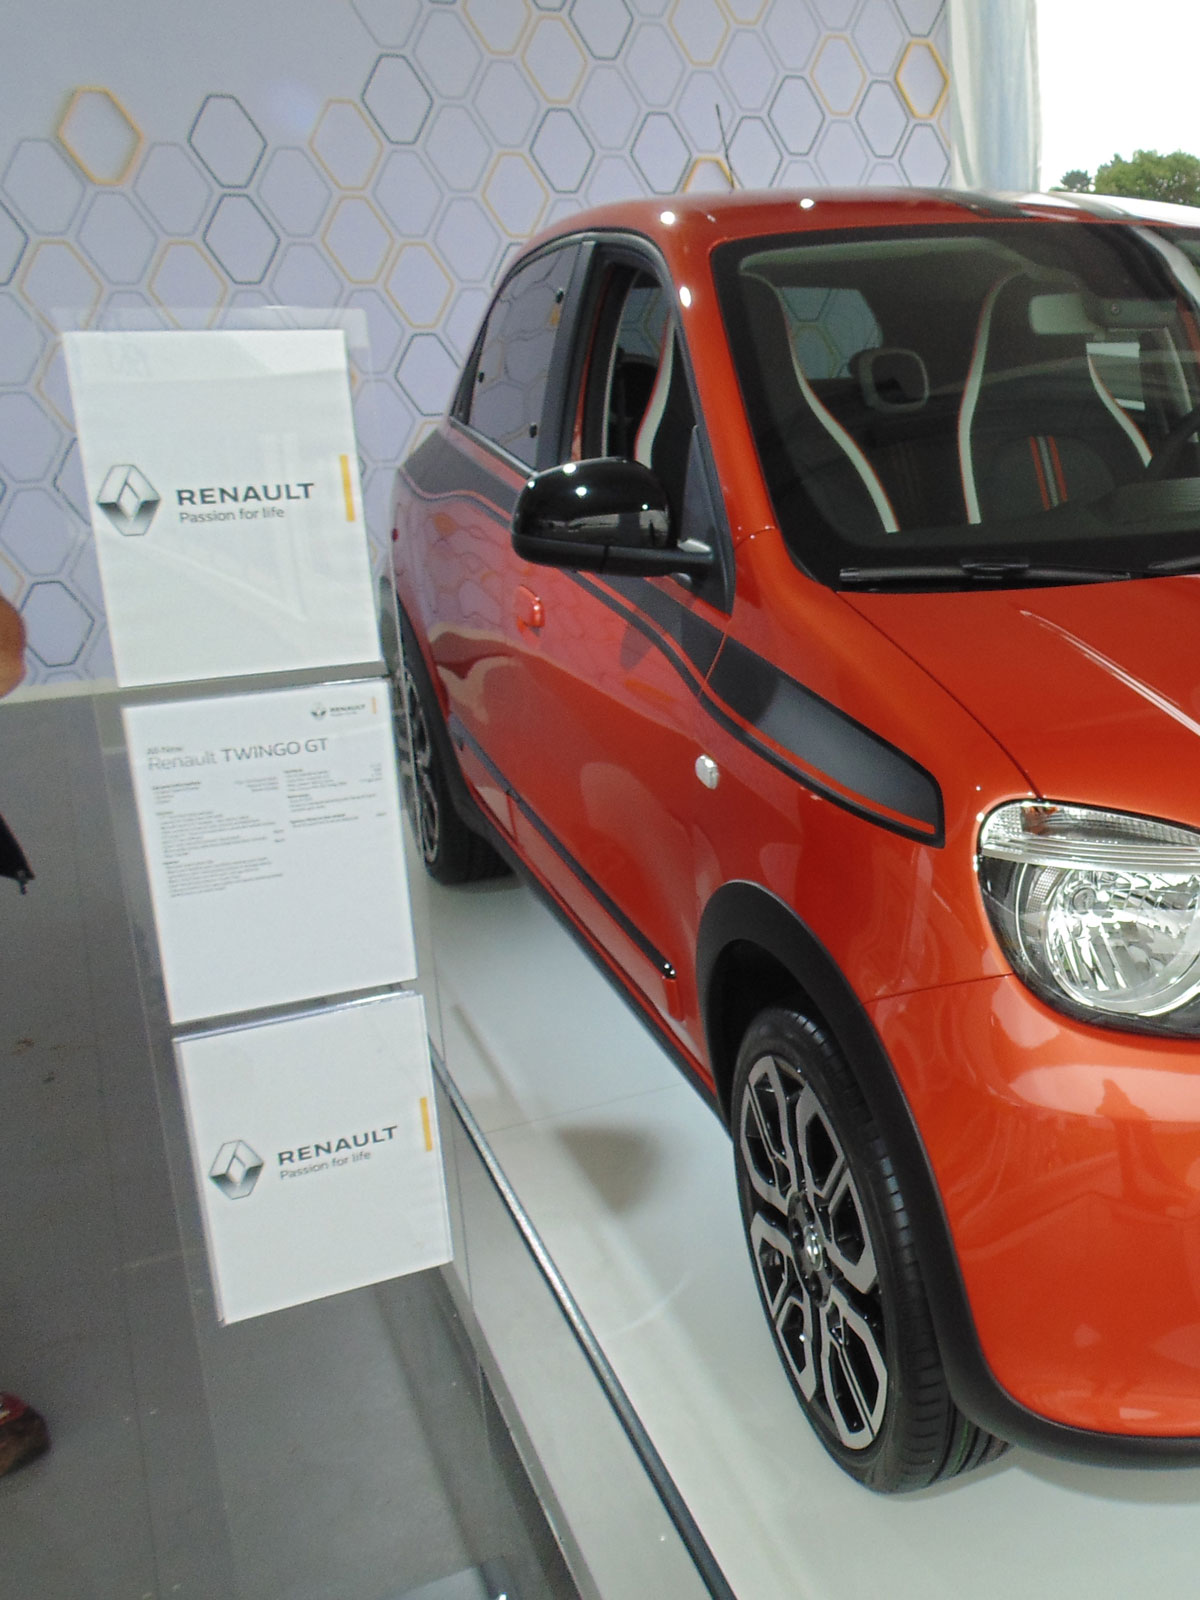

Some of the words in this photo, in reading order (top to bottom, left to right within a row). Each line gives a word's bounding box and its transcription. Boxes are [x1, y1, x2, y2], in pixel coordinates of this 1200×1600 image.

[176, 482, 315, 506] RENAULT
[179, 510, 235, 524] Passion
[239, 508, 260, 520] for
[263, 506, 285, 519] life
[148, 750, 218, 770] Renault
[220, 741, 302, 763] TWINGO
[304, 737, 330, 753] GT
[277, 1125, 399, 1167] RENAULT
[279, 1161, 330, 1181] Passion
[332, 1155, 350, 1168] for
[352, 1149, 372, 1163] life
